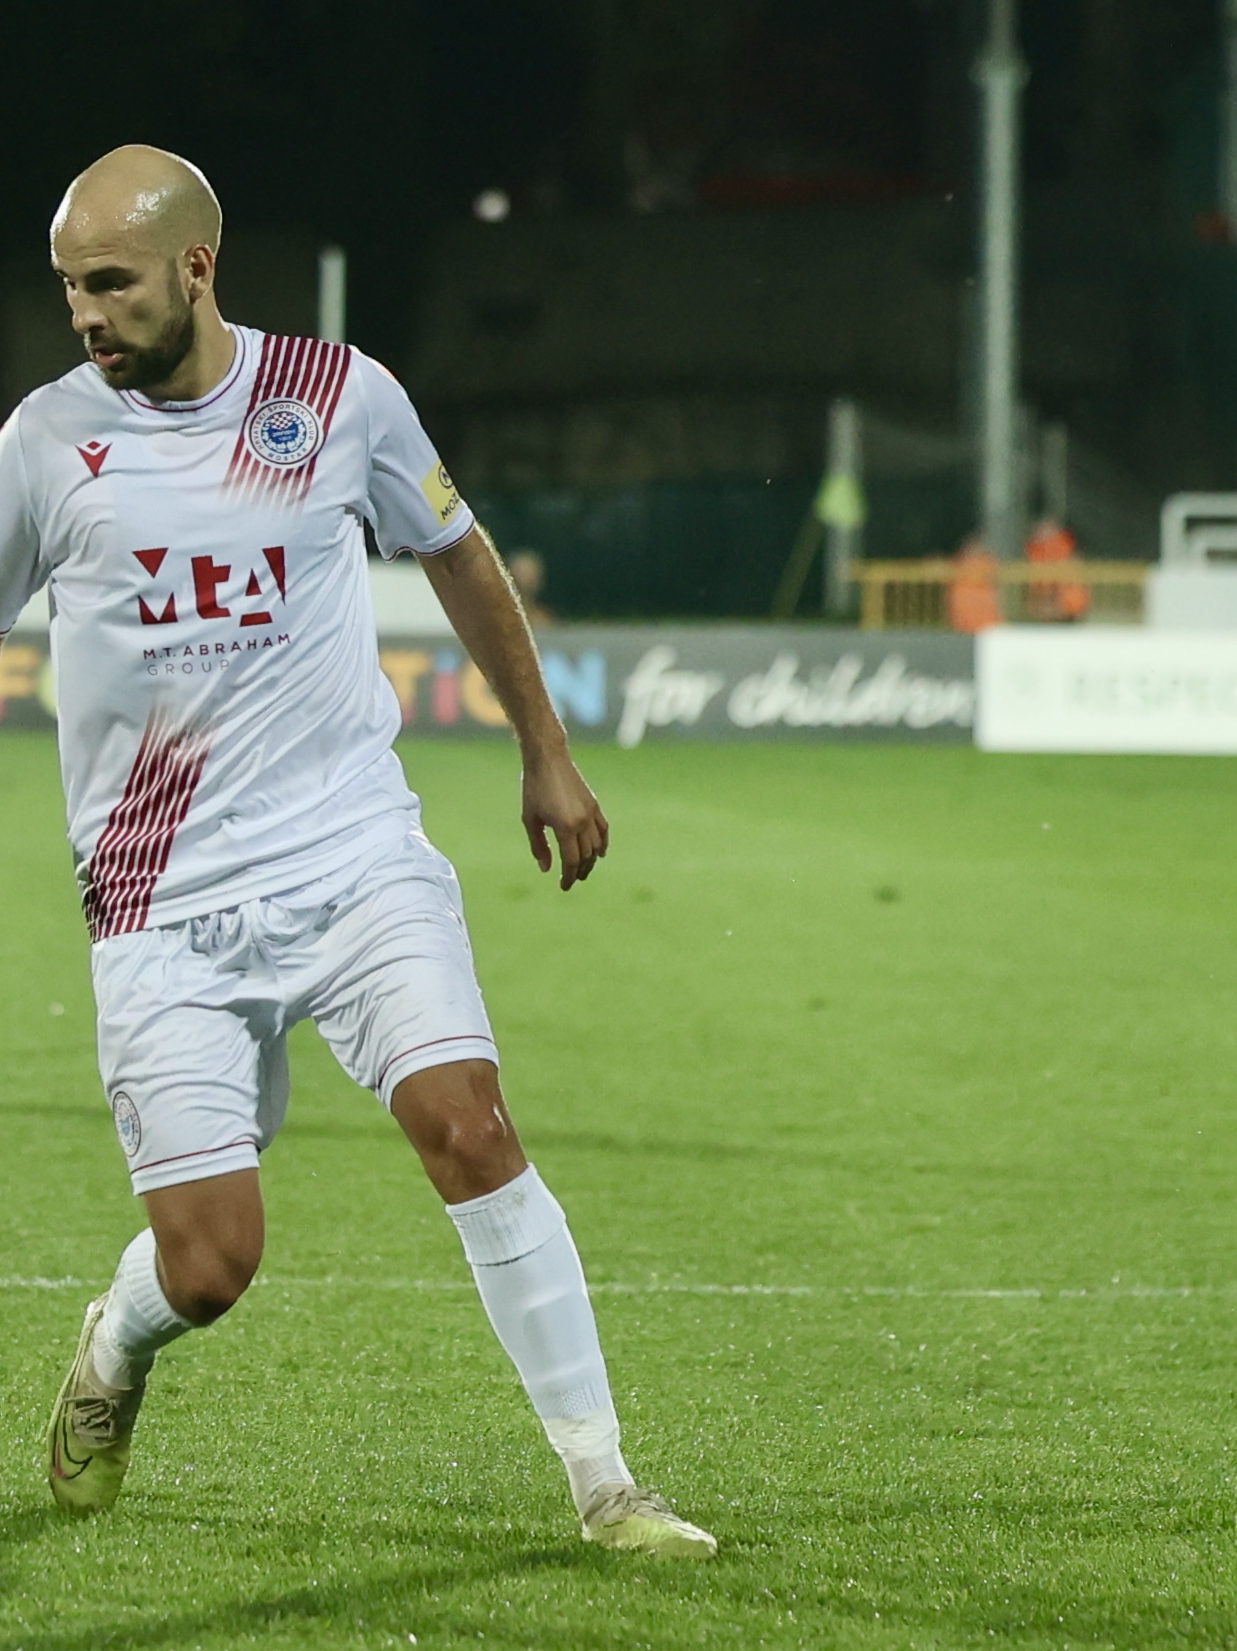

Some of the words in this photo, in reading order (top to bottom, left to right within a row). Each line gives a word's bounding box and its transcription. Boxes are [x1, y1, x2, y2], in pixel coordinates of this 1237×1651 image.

[307, 420, 315, 441] KLUB
[268, 447, 307, 461] MOSTAR
[183, 633, 292, 658] ABRAHAM
[147, 659, 230, 676] GROUP
[616, 645, 723, 748] for
[727, 652, 975, 728] children
